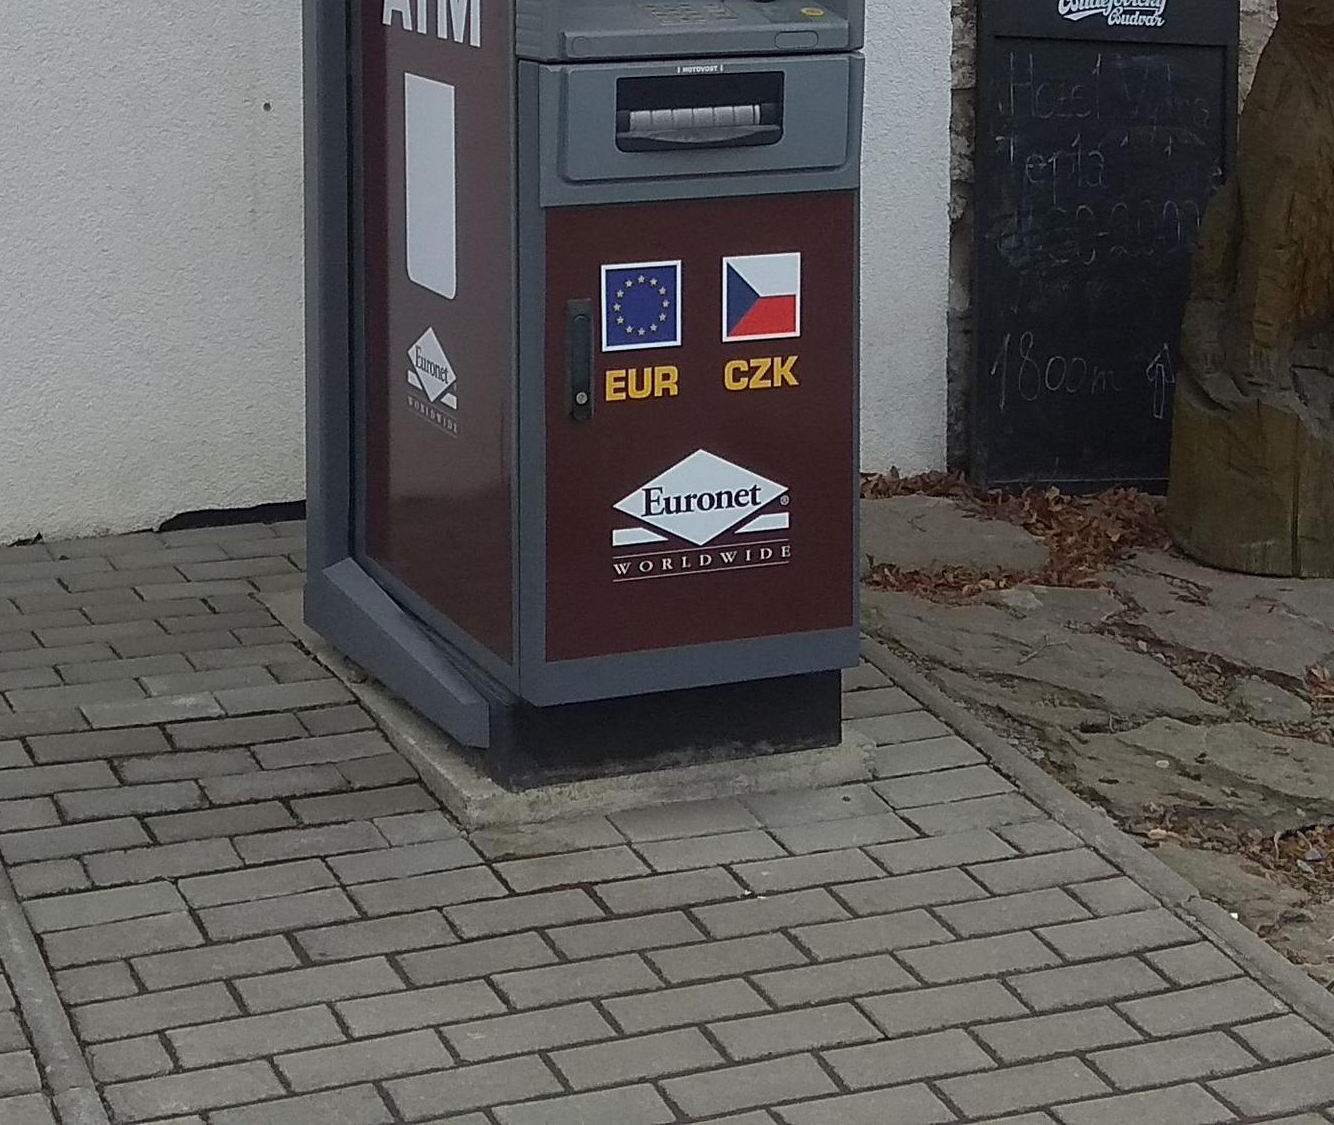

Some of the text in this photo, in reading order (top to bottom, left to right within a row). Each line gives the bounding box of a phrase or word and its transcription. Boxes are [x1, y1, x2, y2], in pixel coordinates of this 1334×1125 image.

[1107, 6, 1165, 27] Budvar
[415, 346, 449, 384] Euronet
[723, 355, 799, 391] CZK
[604, 365, 679, 402] EUR
[640, 484, 762, 518] Euronet
[613, 544, 792, 576] WORLDWIDE
